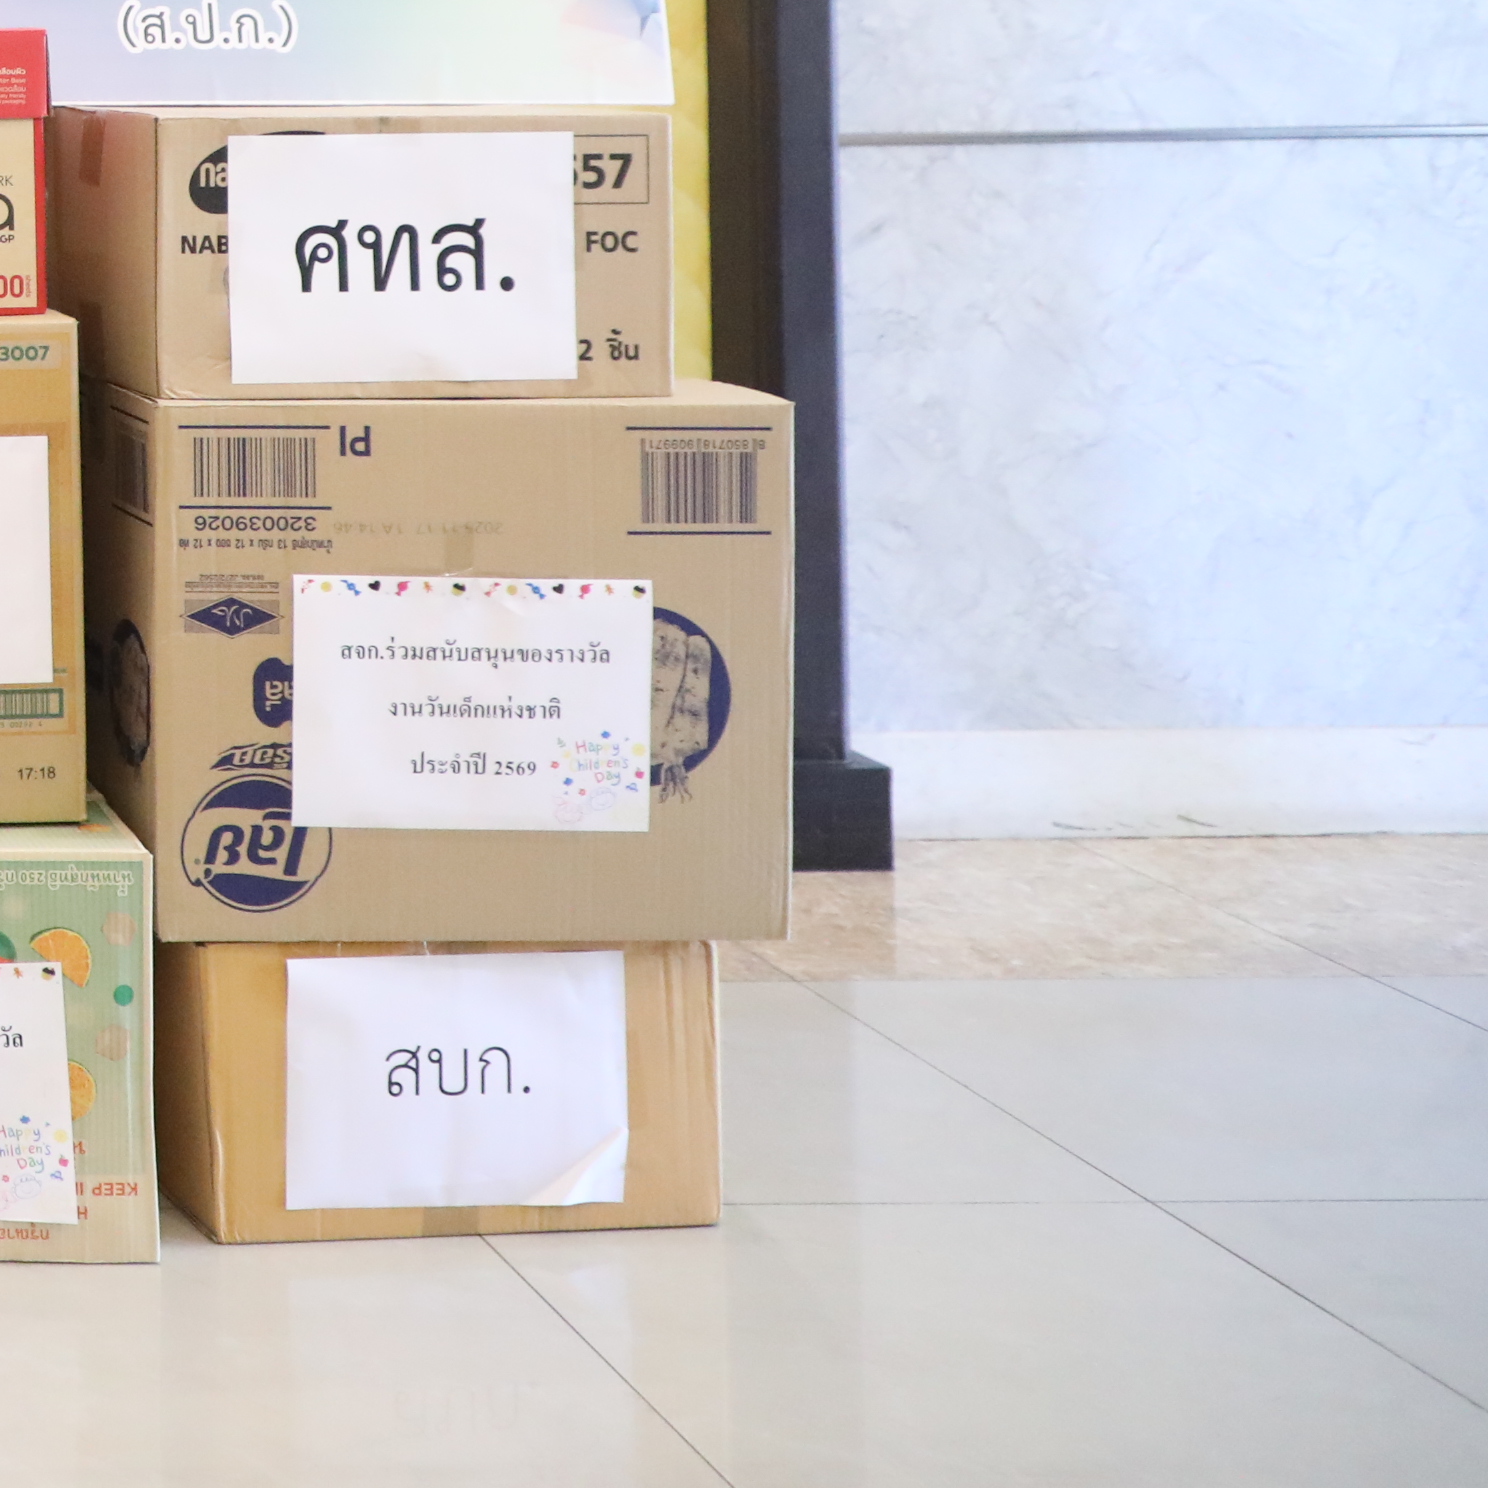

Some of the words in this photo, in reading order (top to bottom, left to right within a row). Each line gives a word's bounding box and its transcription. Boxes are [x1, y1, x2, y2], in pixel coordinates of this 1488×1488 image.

[120, 0, 299, 52] (ส.ป.ก.)
[294, 218, 516, 293] ศทส.
[585, 231, 639, 253] FOC
[606, 328, 640, 361] ชิ้น
[194, 515, 317, 532] 320039026
[340, 637, 611, 670] สจก.ร่วมสนับสนุนของรางวัล
[388, 694, 561, 722] งานวันเด็กแห่งชาติ
[17, 766, 57, 780] 17:18
[411, 751, 487, 777] ประจำปี
[494, 760, 537, 777] 2569
[20, 871, 44, 885] 250
[384, 1045, 532, 1098] สบก.
[92, 1182, 138, 1196] KEEP
